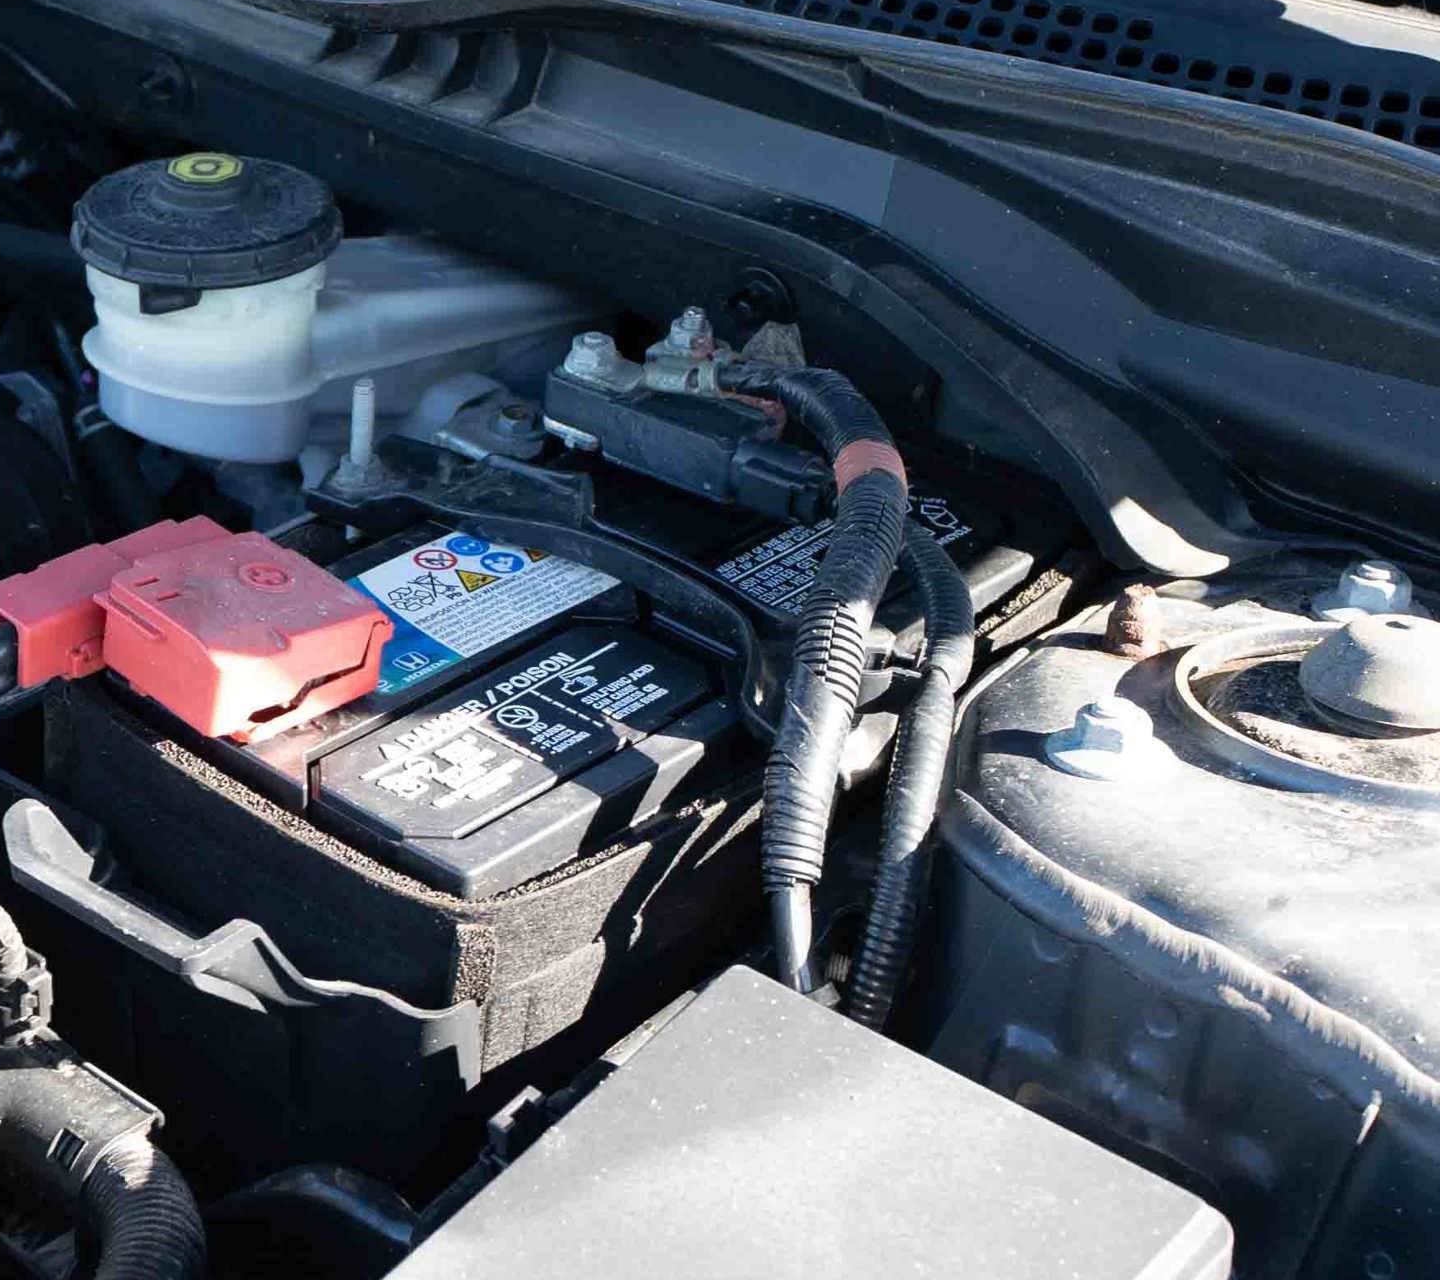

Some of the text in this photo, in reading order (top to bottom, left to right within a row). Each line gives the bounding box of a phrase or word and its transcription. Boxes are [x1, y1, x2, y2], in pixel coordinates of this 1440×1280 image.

[403, 659, 450, 682] HONDA
[495, 652, 576, 696] POISON
[580, 664, 655, 705] SULFURIC ACID
[592, 697, 614, 710] CAN
[526, 721, 548, 734] NO
